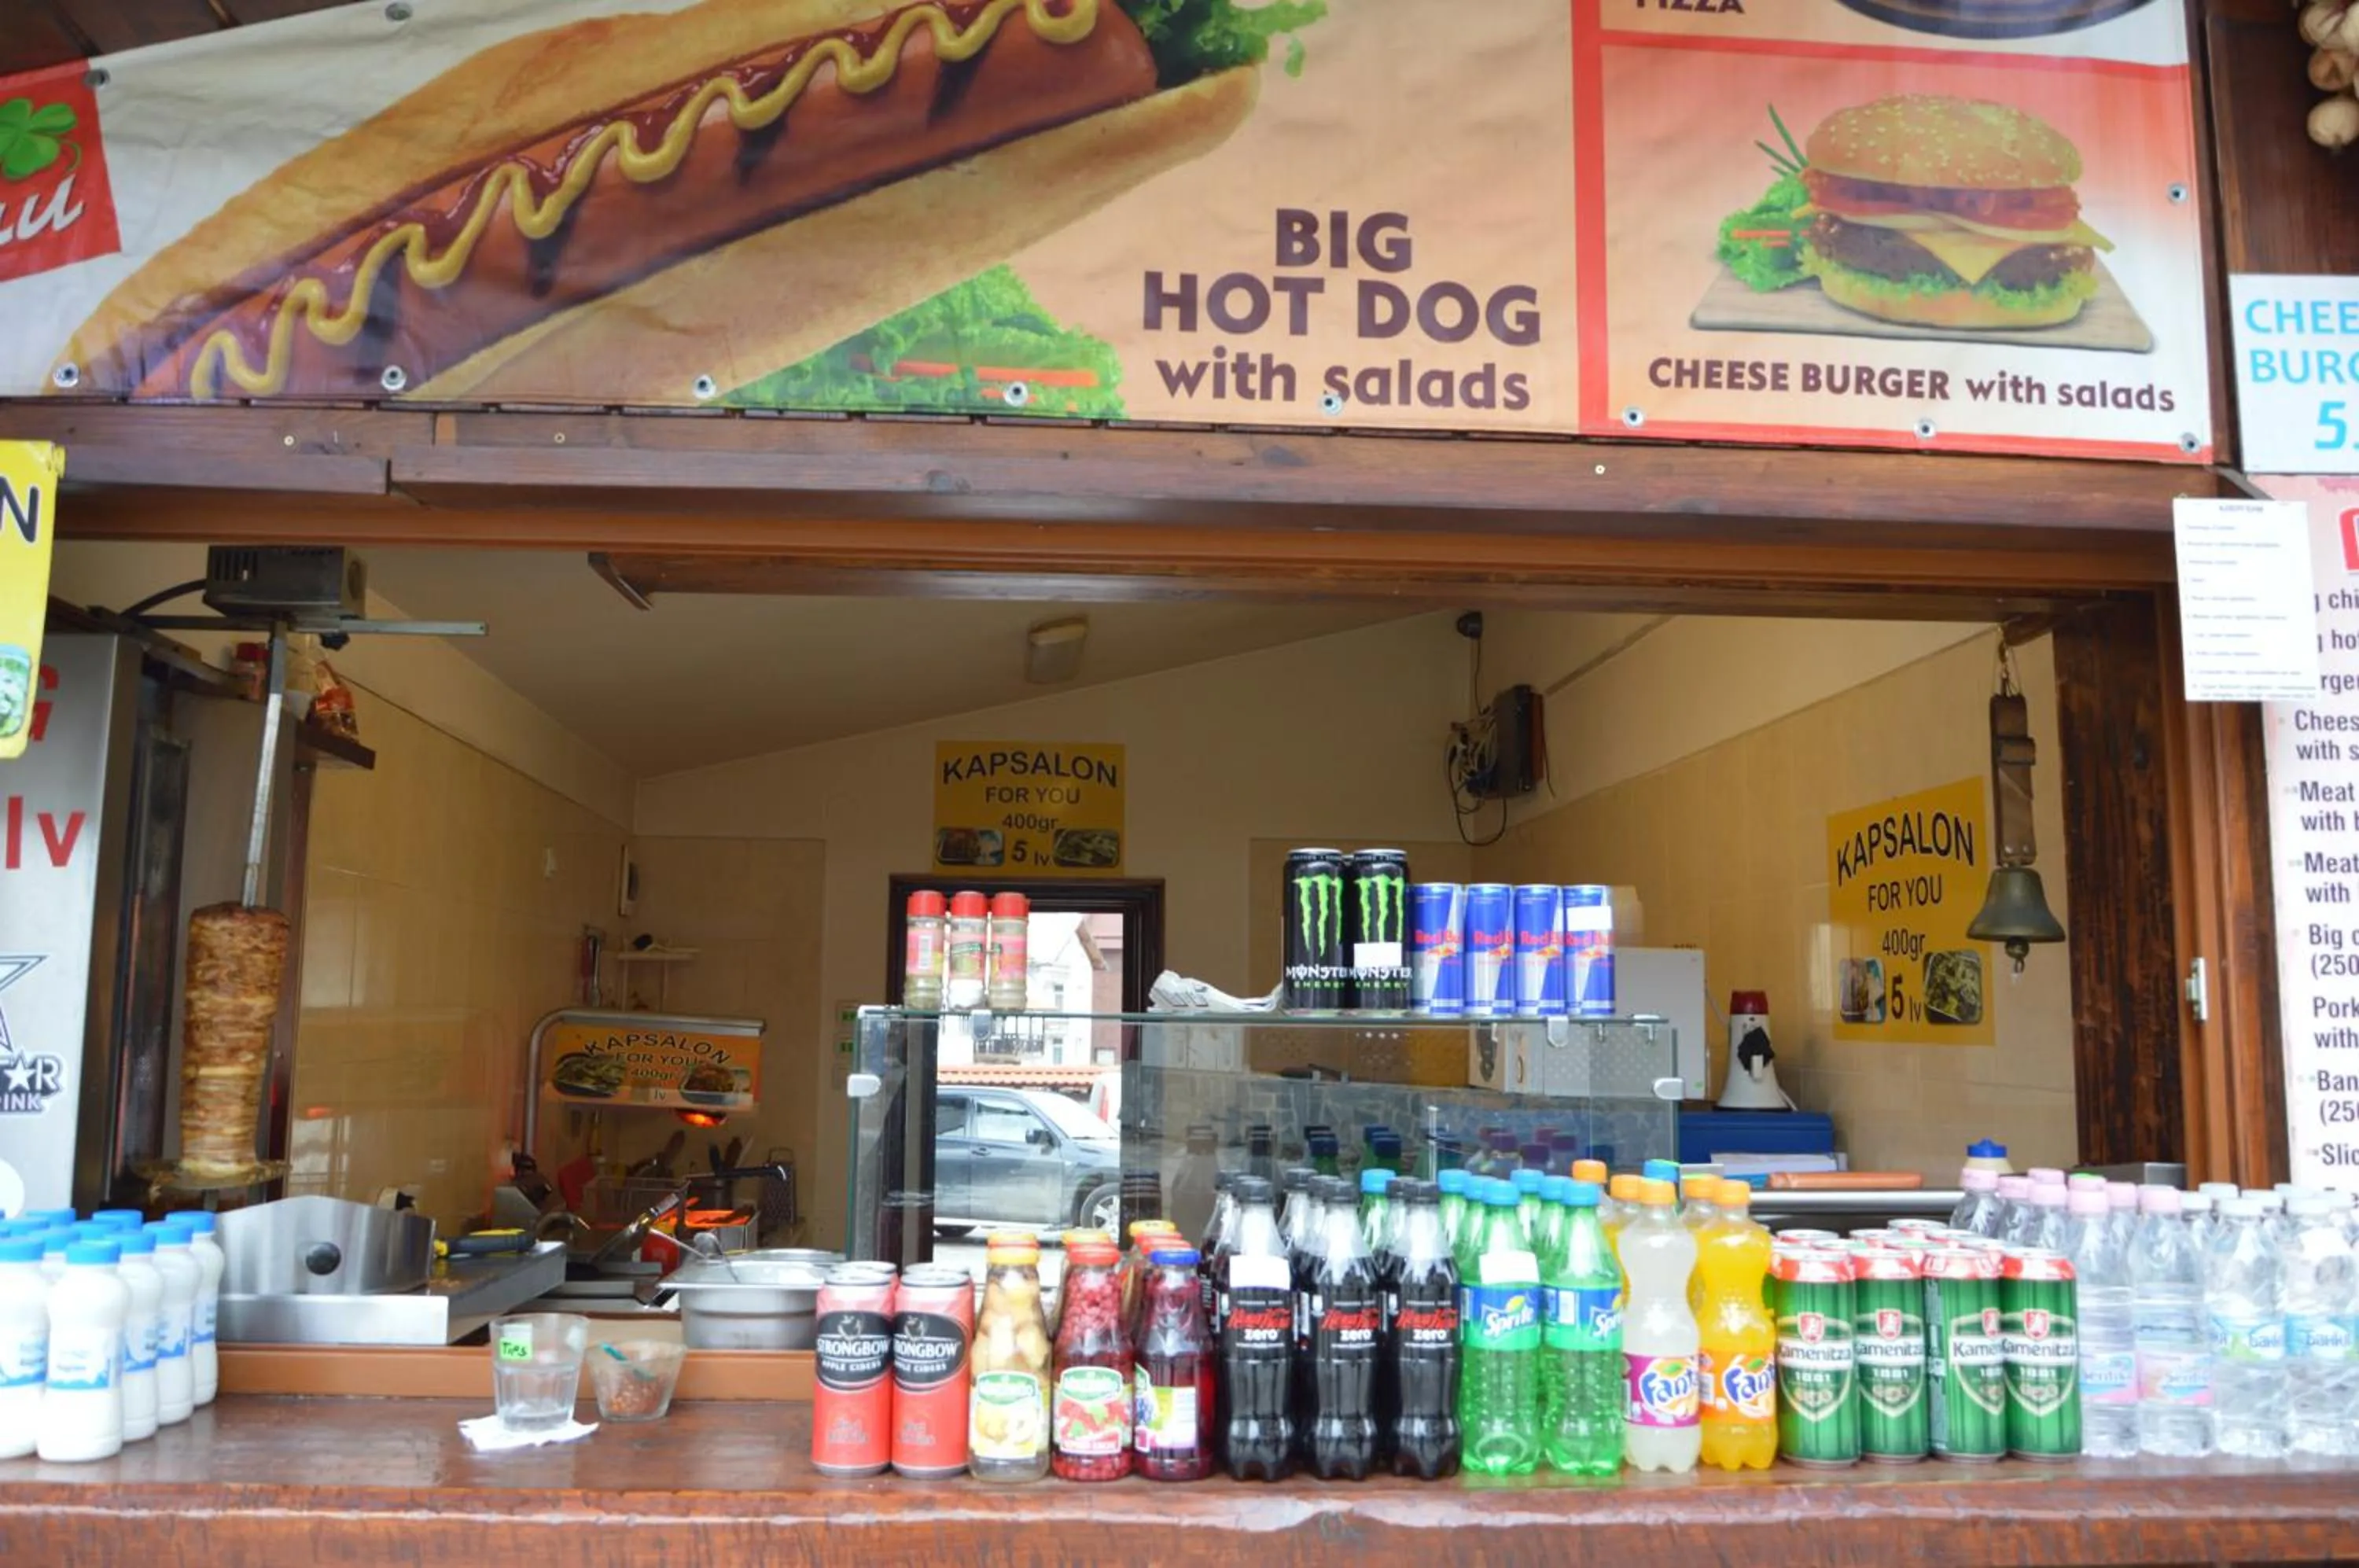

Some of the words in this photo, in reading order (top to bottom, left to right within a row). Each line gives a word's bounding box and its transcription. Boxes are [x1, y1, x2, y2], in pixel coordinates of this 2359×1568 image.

[1275, 208, 1412, 274] BIG
[1143, 270, 1325, 337] HOT
[1356, 278, 1541, 347] DOG
[1154, 344, 1297, 402] with
[1323, 358, 1531, 410] salads
[1647, 356, 1790, 393] CHEESE
[1801, 362, 1952, 401] BURGER
[1965, 369, 2047, 406] with
[2056, 378, 2177, 413] salads
[2331, 628, 2359, 650] ho
[2296, 738, 2341, 761] with
[943, 749, 1117, 789] KAPSALON
[985, 786, 1029, 804] FOR
[1036, 786, 1081, 805] YOU
[2298, 779, 2356, 803] Meat
[1001, 813, 1059, 834] 400gr
[2300, 809, 2346, 832] with
[1010, 839, 1029, 863] 5
[1836, 811, 1975, 889] KAPSALON
[1868, 881, 1902, 913] FOR
[1904, 873, 1943, 906] YOU
[2305, 881, 2350, 904] with
[1882, 927, 1926, 963] 400gr
[2308, 922, 2343, 951] Big
[1890, 974, 1904, 1020] 5
[583, 1033, 732, 1064] KAPSALON
[616, 1051, 654, 1064] FOR
[2319, 1099, 2359, 1128] (25
